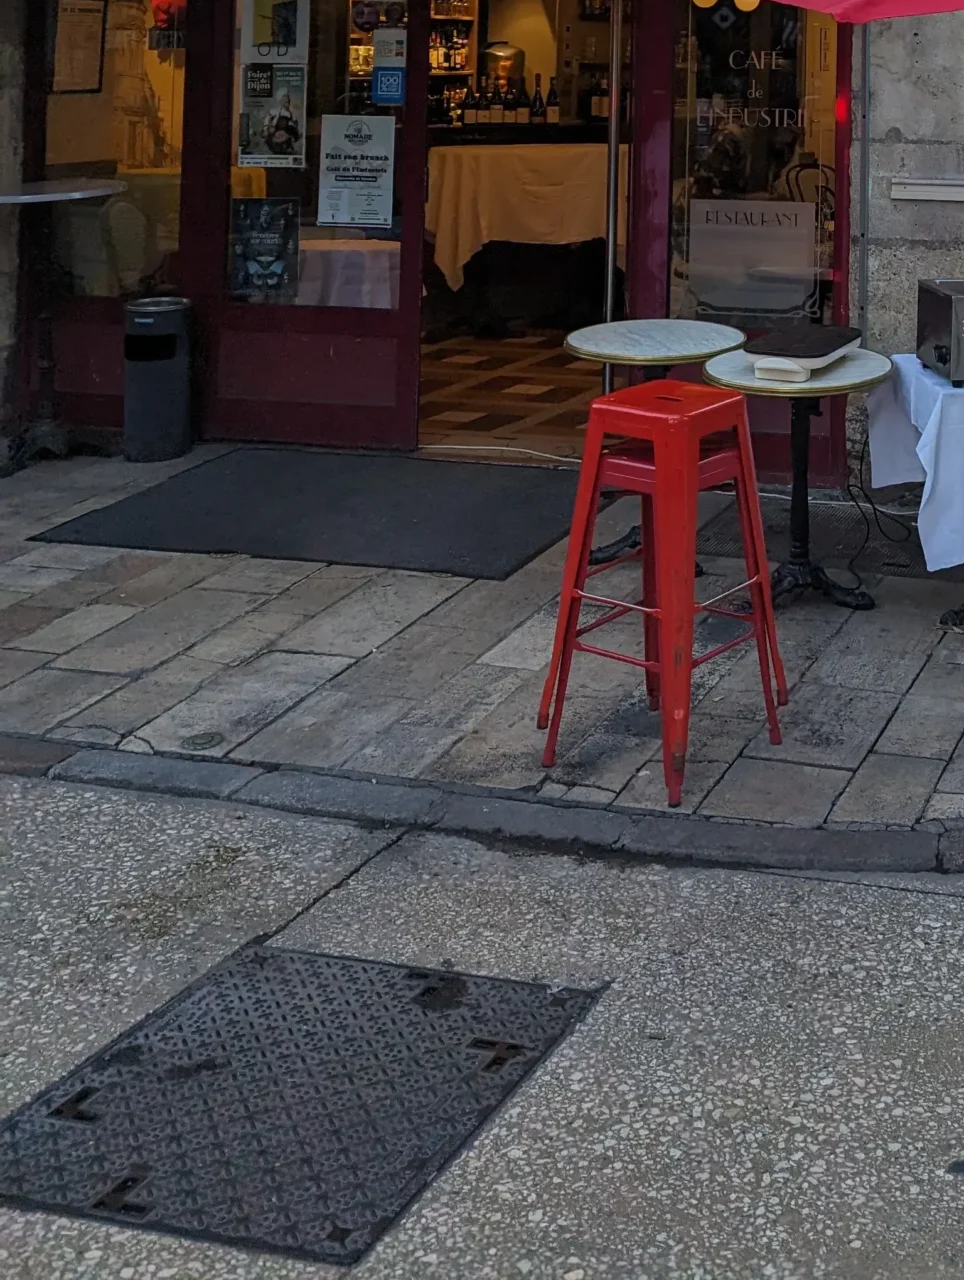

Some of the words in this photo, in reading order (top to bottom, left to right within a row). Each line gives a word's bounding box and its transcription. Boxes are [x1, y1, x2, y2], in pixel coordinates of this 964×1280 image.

[728, 45, 784, 70] CAFÉ
[247, 81, 271, 91] Dijon
[380, 76, 399, 85] 100
[746, 79, 764, 99] de
[705, 209, 800, 228] RESTAURANT
